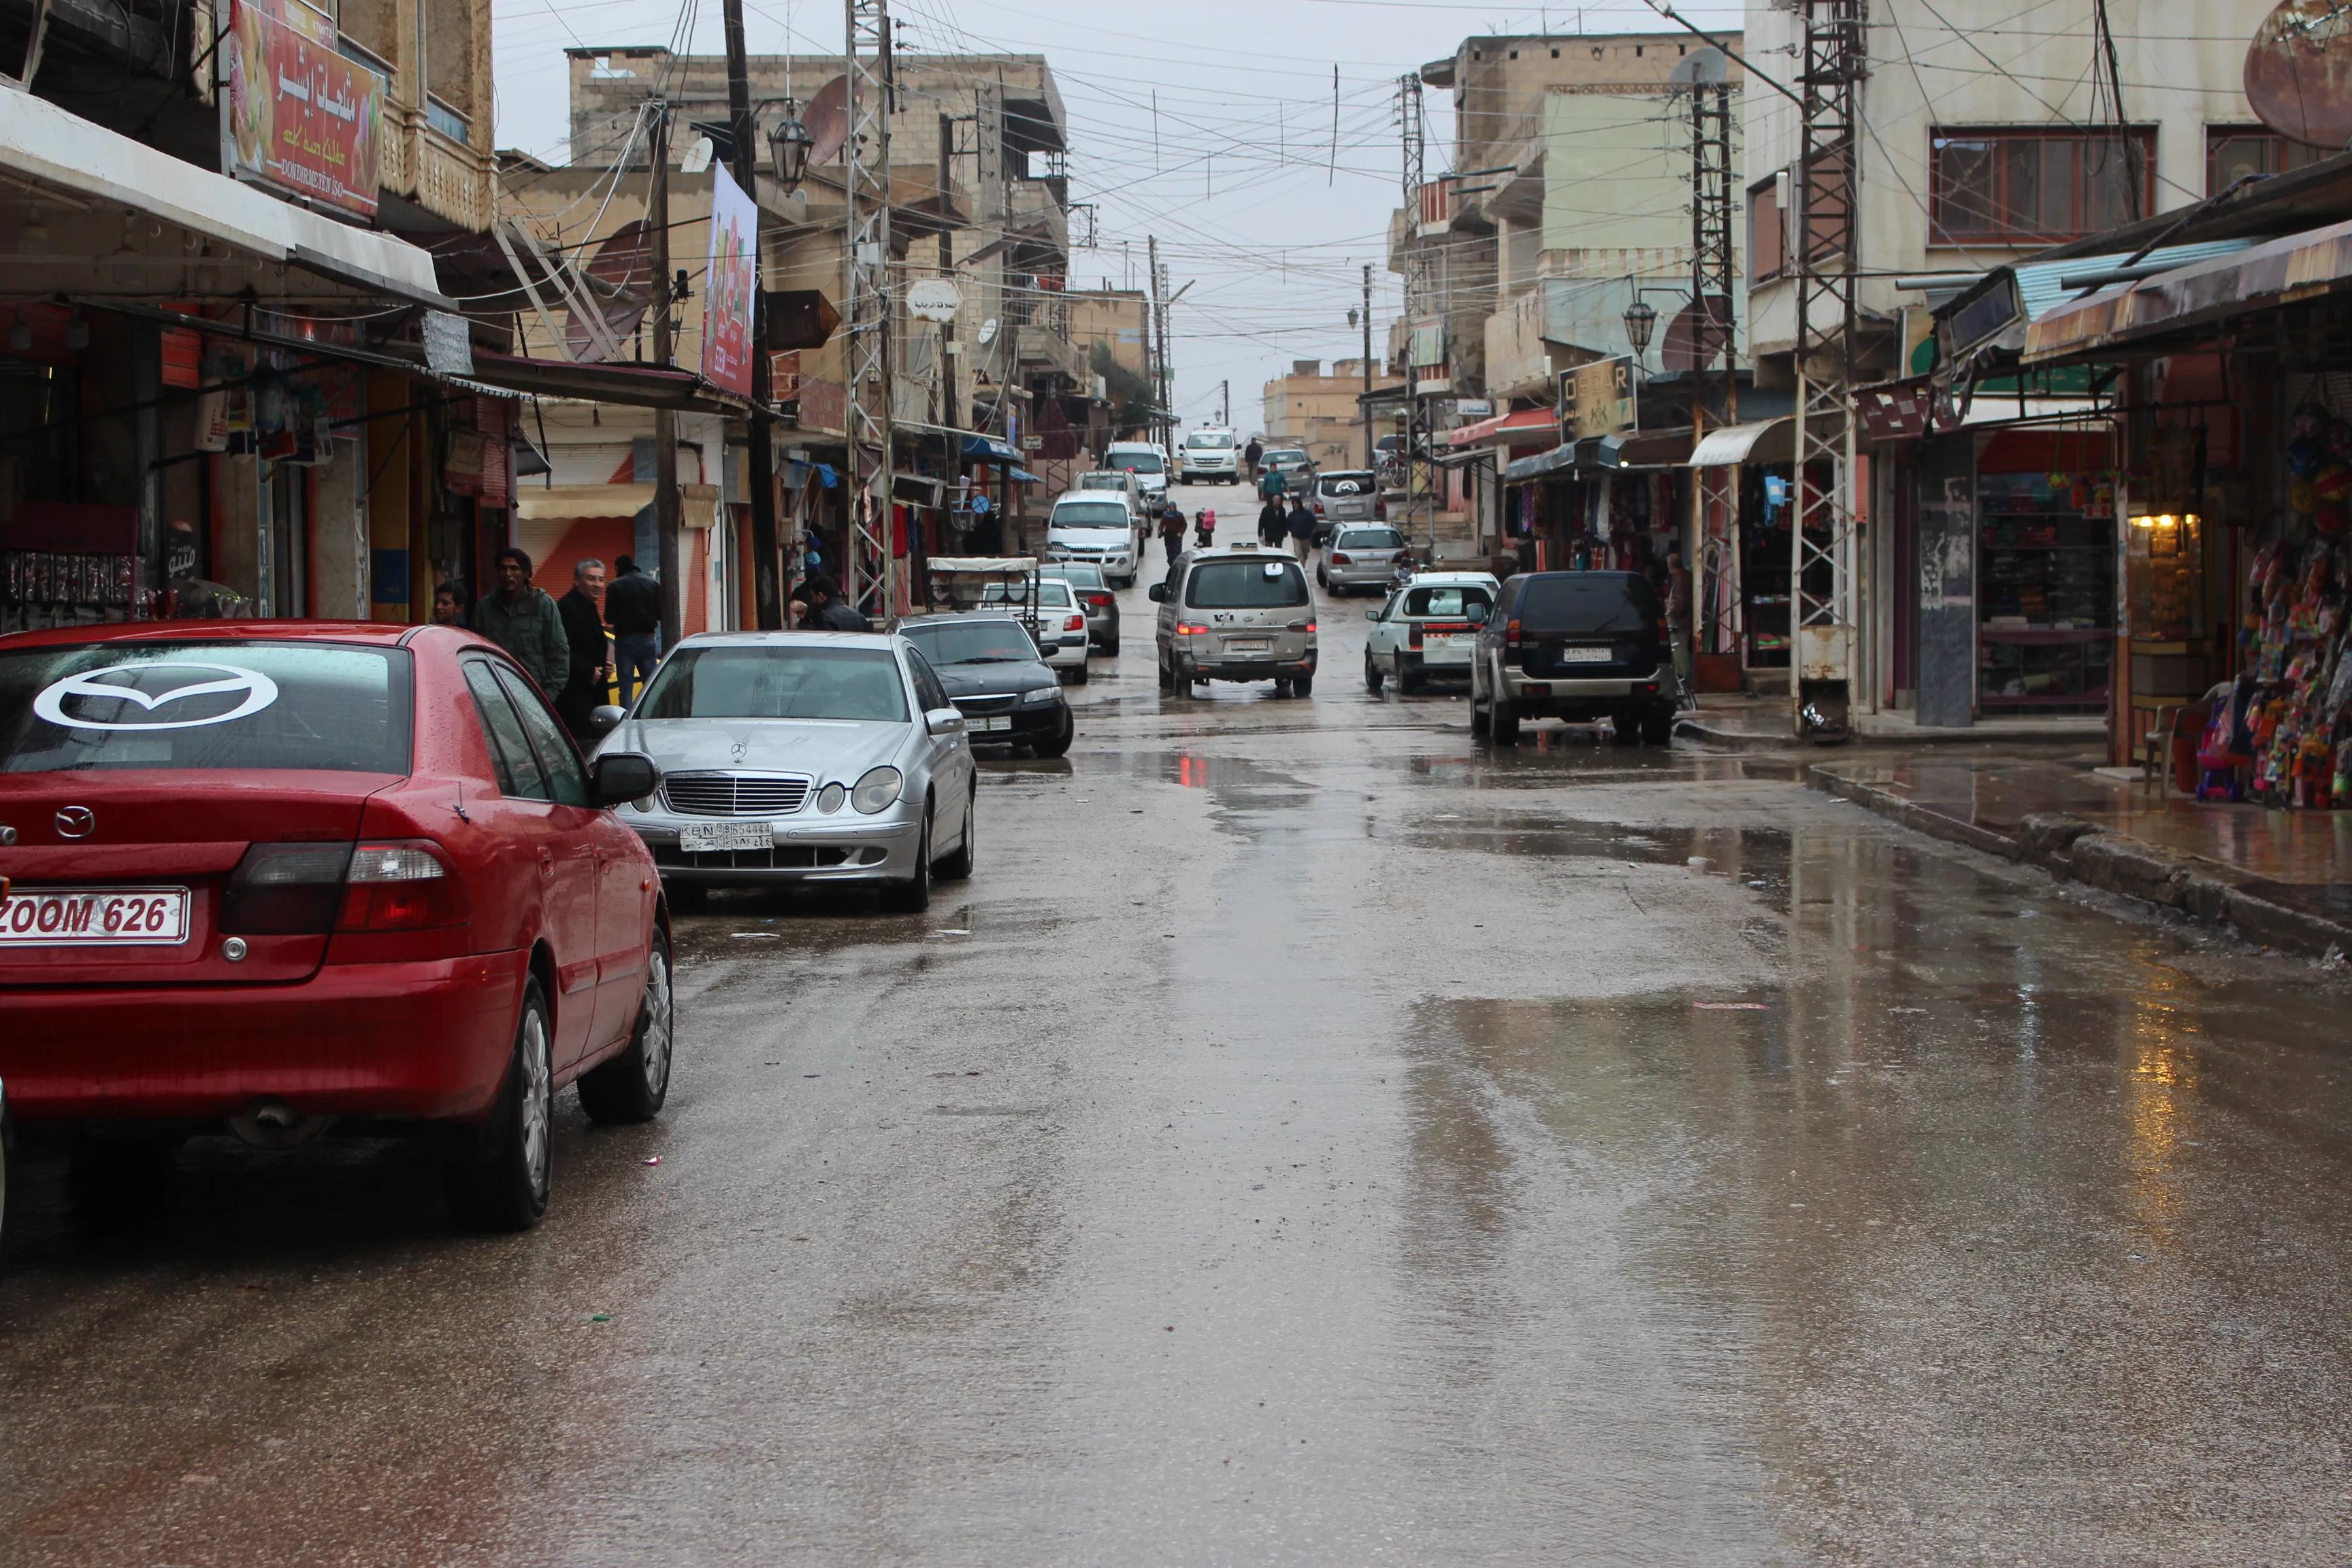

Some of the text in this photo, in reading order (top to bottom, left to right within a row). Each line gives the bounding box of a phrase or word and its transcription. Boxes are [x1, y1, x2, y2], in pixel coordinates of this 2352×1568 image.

[277, 45, 355, 129] مثلجات إيشو
[1565, 366, 1627, 401] OSCAR
[103, 898, 167, 932] 626
